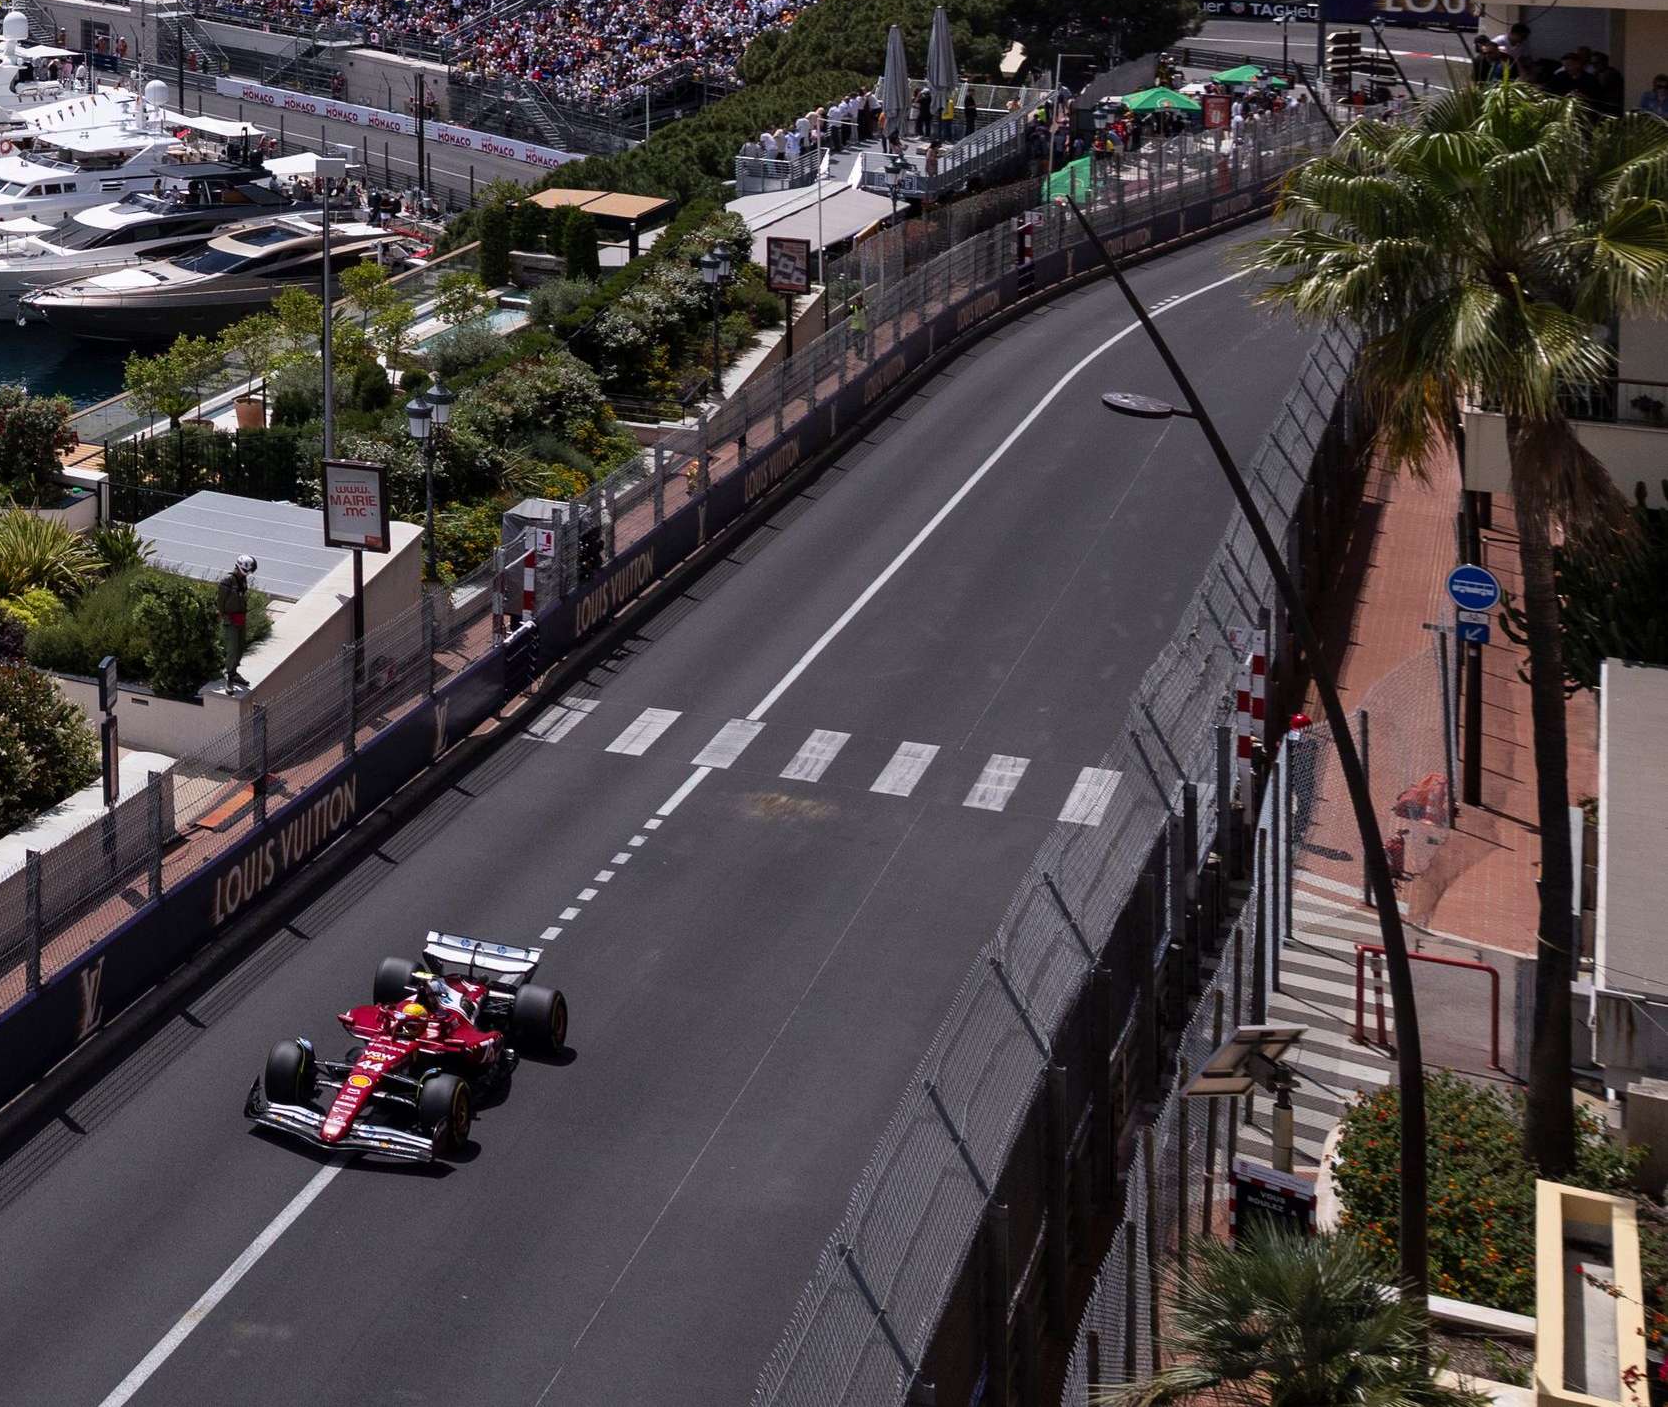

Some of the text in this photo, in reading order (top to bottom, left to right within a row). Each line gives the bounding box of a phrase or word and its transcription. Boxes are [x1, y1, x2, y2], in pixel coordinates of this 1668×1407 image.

[242, 90, 274, 104] MONACO
[284, 99, 316, 113] MONACO
[326, 107, 358, 121] MONACO
[368, 117, 401, 131] MONACO
[438, 132, 471, 147] MONACO
[481, 142, 515, 157] MONACO
[525, 152, 559, 168] MONACO
[330, 495, 377, 507] MAIRIE
[576, 545, 654, 638] LOUIS VUITTON
[215, 773, 356, 925] LOUIS VUITTON
[357, 1060, 383, 1072] 44
